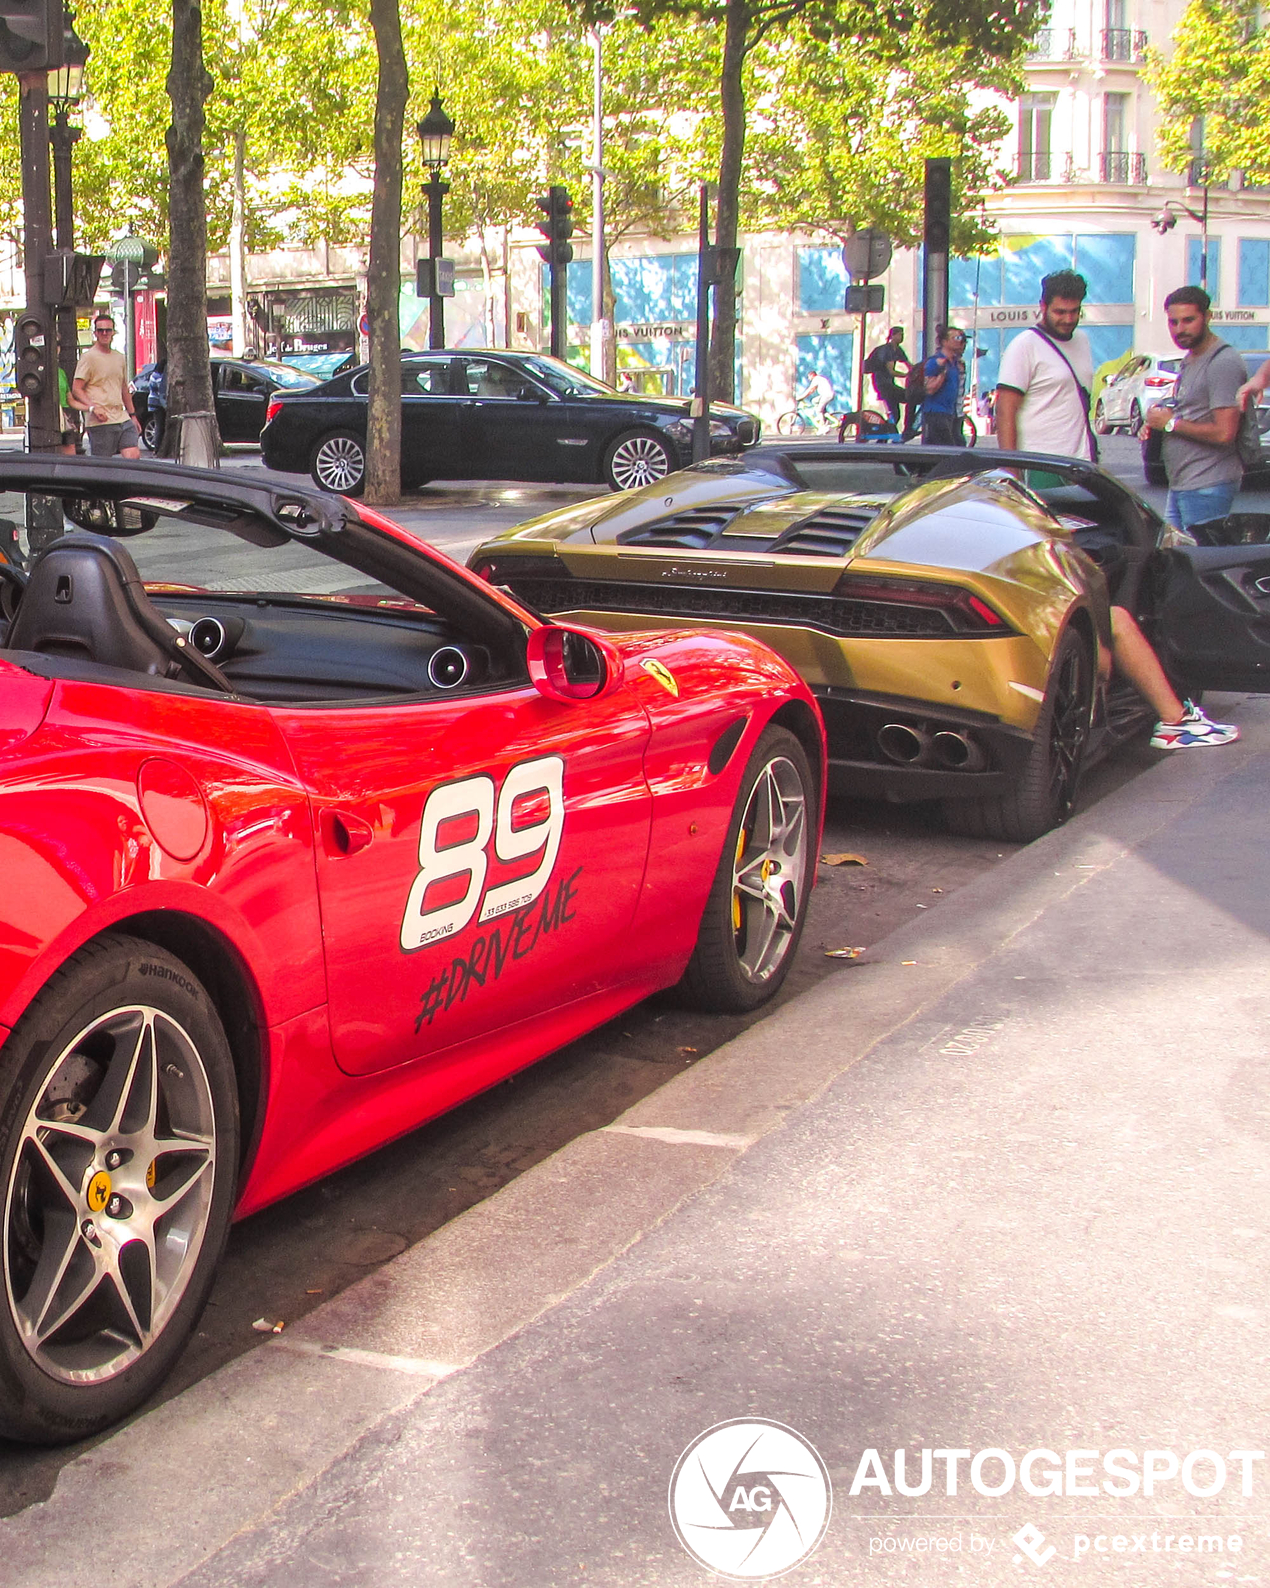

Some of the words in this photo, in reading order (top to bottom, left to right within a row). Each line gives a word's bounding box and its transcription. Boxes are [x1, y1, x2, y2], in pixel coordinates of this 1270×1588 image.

[991, 311, 1028, 321] LOUIS
[634, 326, 682, 337] VUITTON
[267, 341, 287, 354] Jef
[294, 339, 328, 352] Bruges
[400, 753, 565, 952] 89
[420, 922, 454, 943] BOOKING
[149, 964, 199, 1000] Hankook
